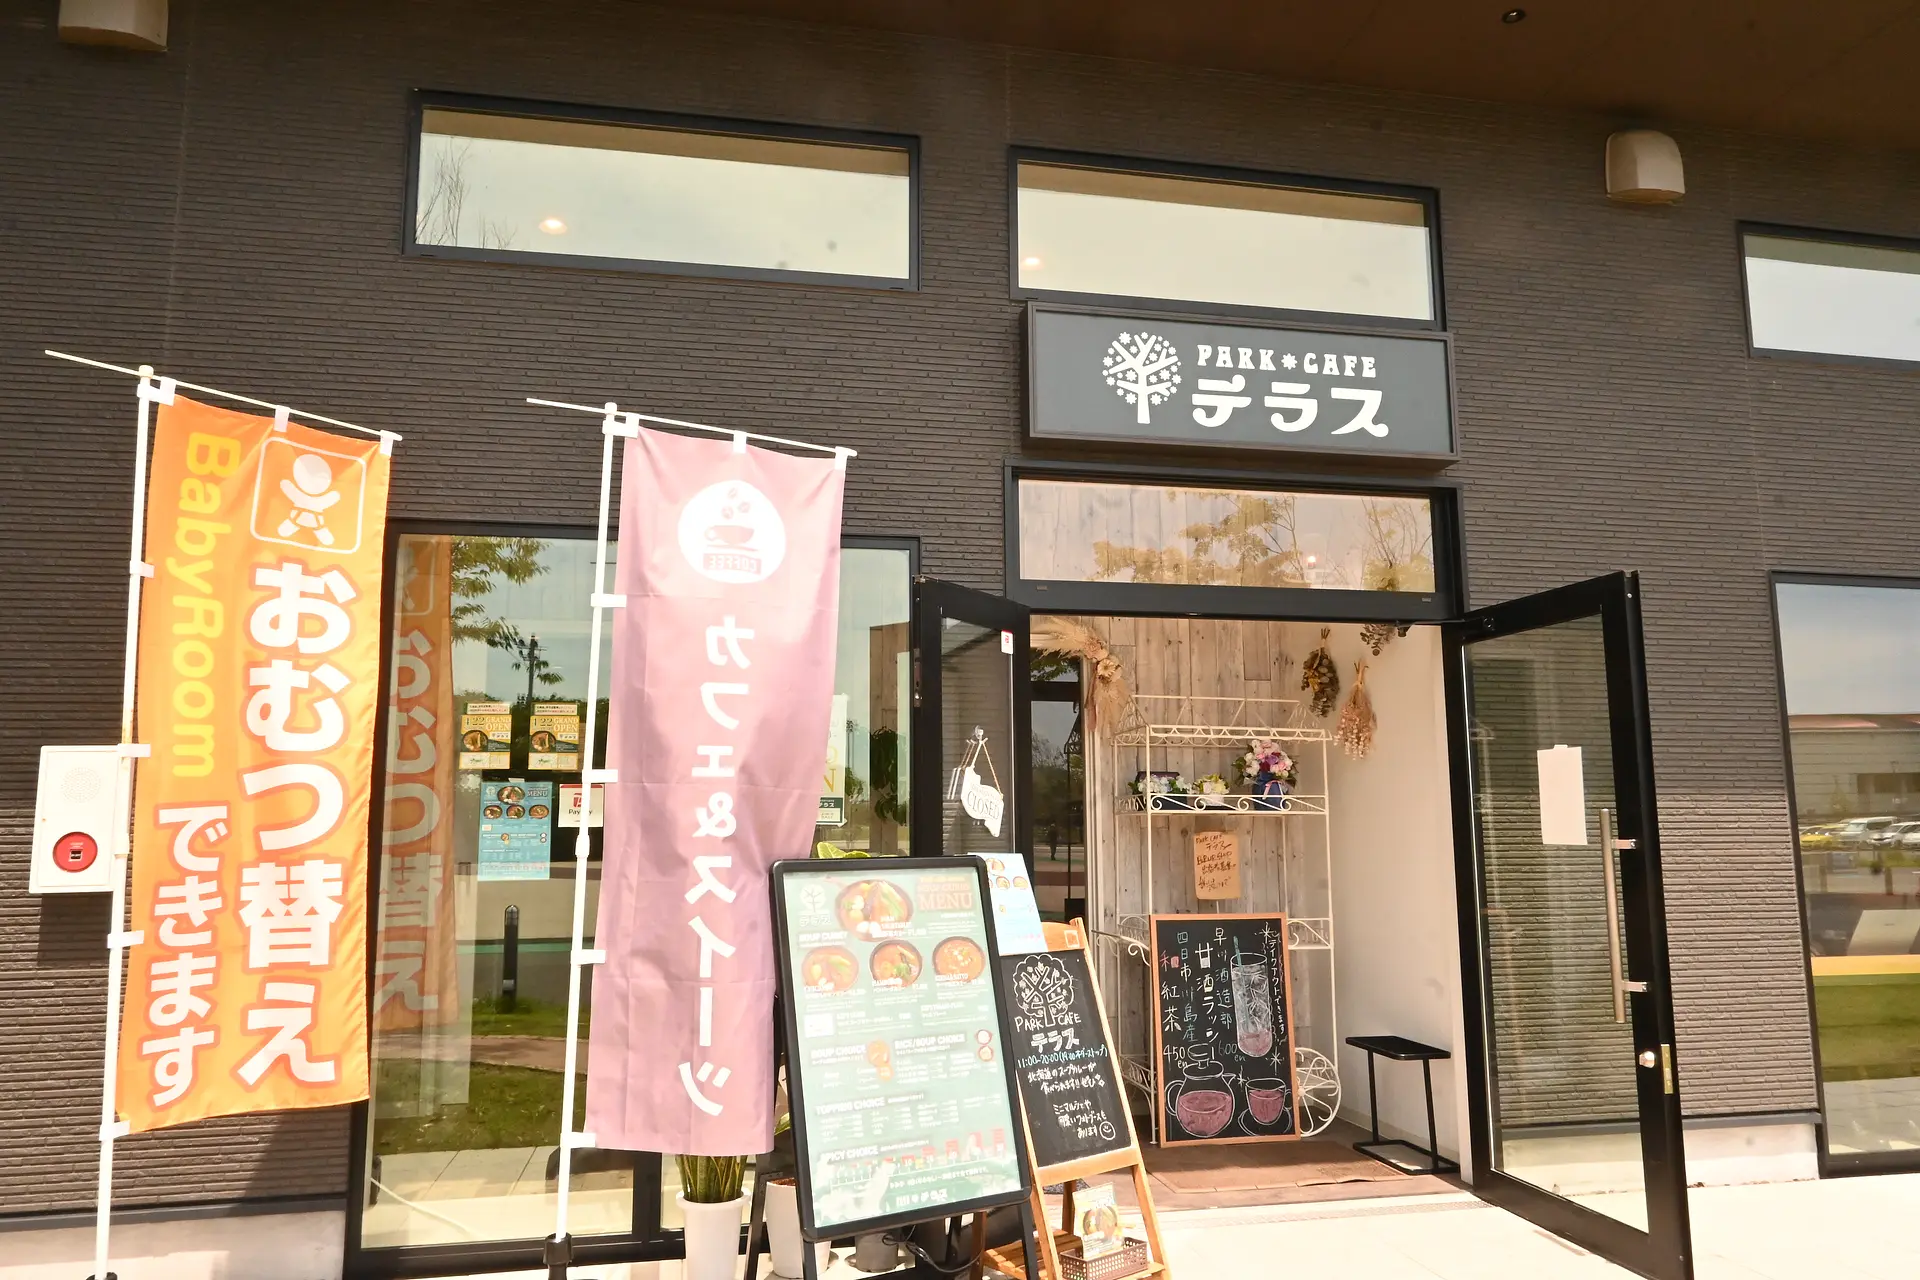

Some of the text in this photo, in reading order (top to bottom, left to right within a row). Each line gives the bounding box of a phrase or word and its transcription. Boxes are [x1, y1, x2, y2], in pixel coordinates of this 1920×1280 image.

[1197, 344, 1376, 378] PARK CAFE
[1192, 374, 1389, 438] テラス
[166, 431, 241, 778] BabyRoom
[486, 722, 510, 731] OPEN
[553, 723, 578, 732] OPEN
[967, 790, 999, 820] CLOSED
[237, 562, 357, 1086] おむつ替え
[918, 892, 973, 911] MENU
[142, 805, 228, 1107] できます
[1160, 949, 1182, 1032] 和紅茶
[1014, 1012, 1082, 1032] PARK CAFE
[1030, 1027, 1080, 1054] テラス
[1163, 1044, 1186, 1065] 450
[1077, 1125, 1098, 1139] あります
